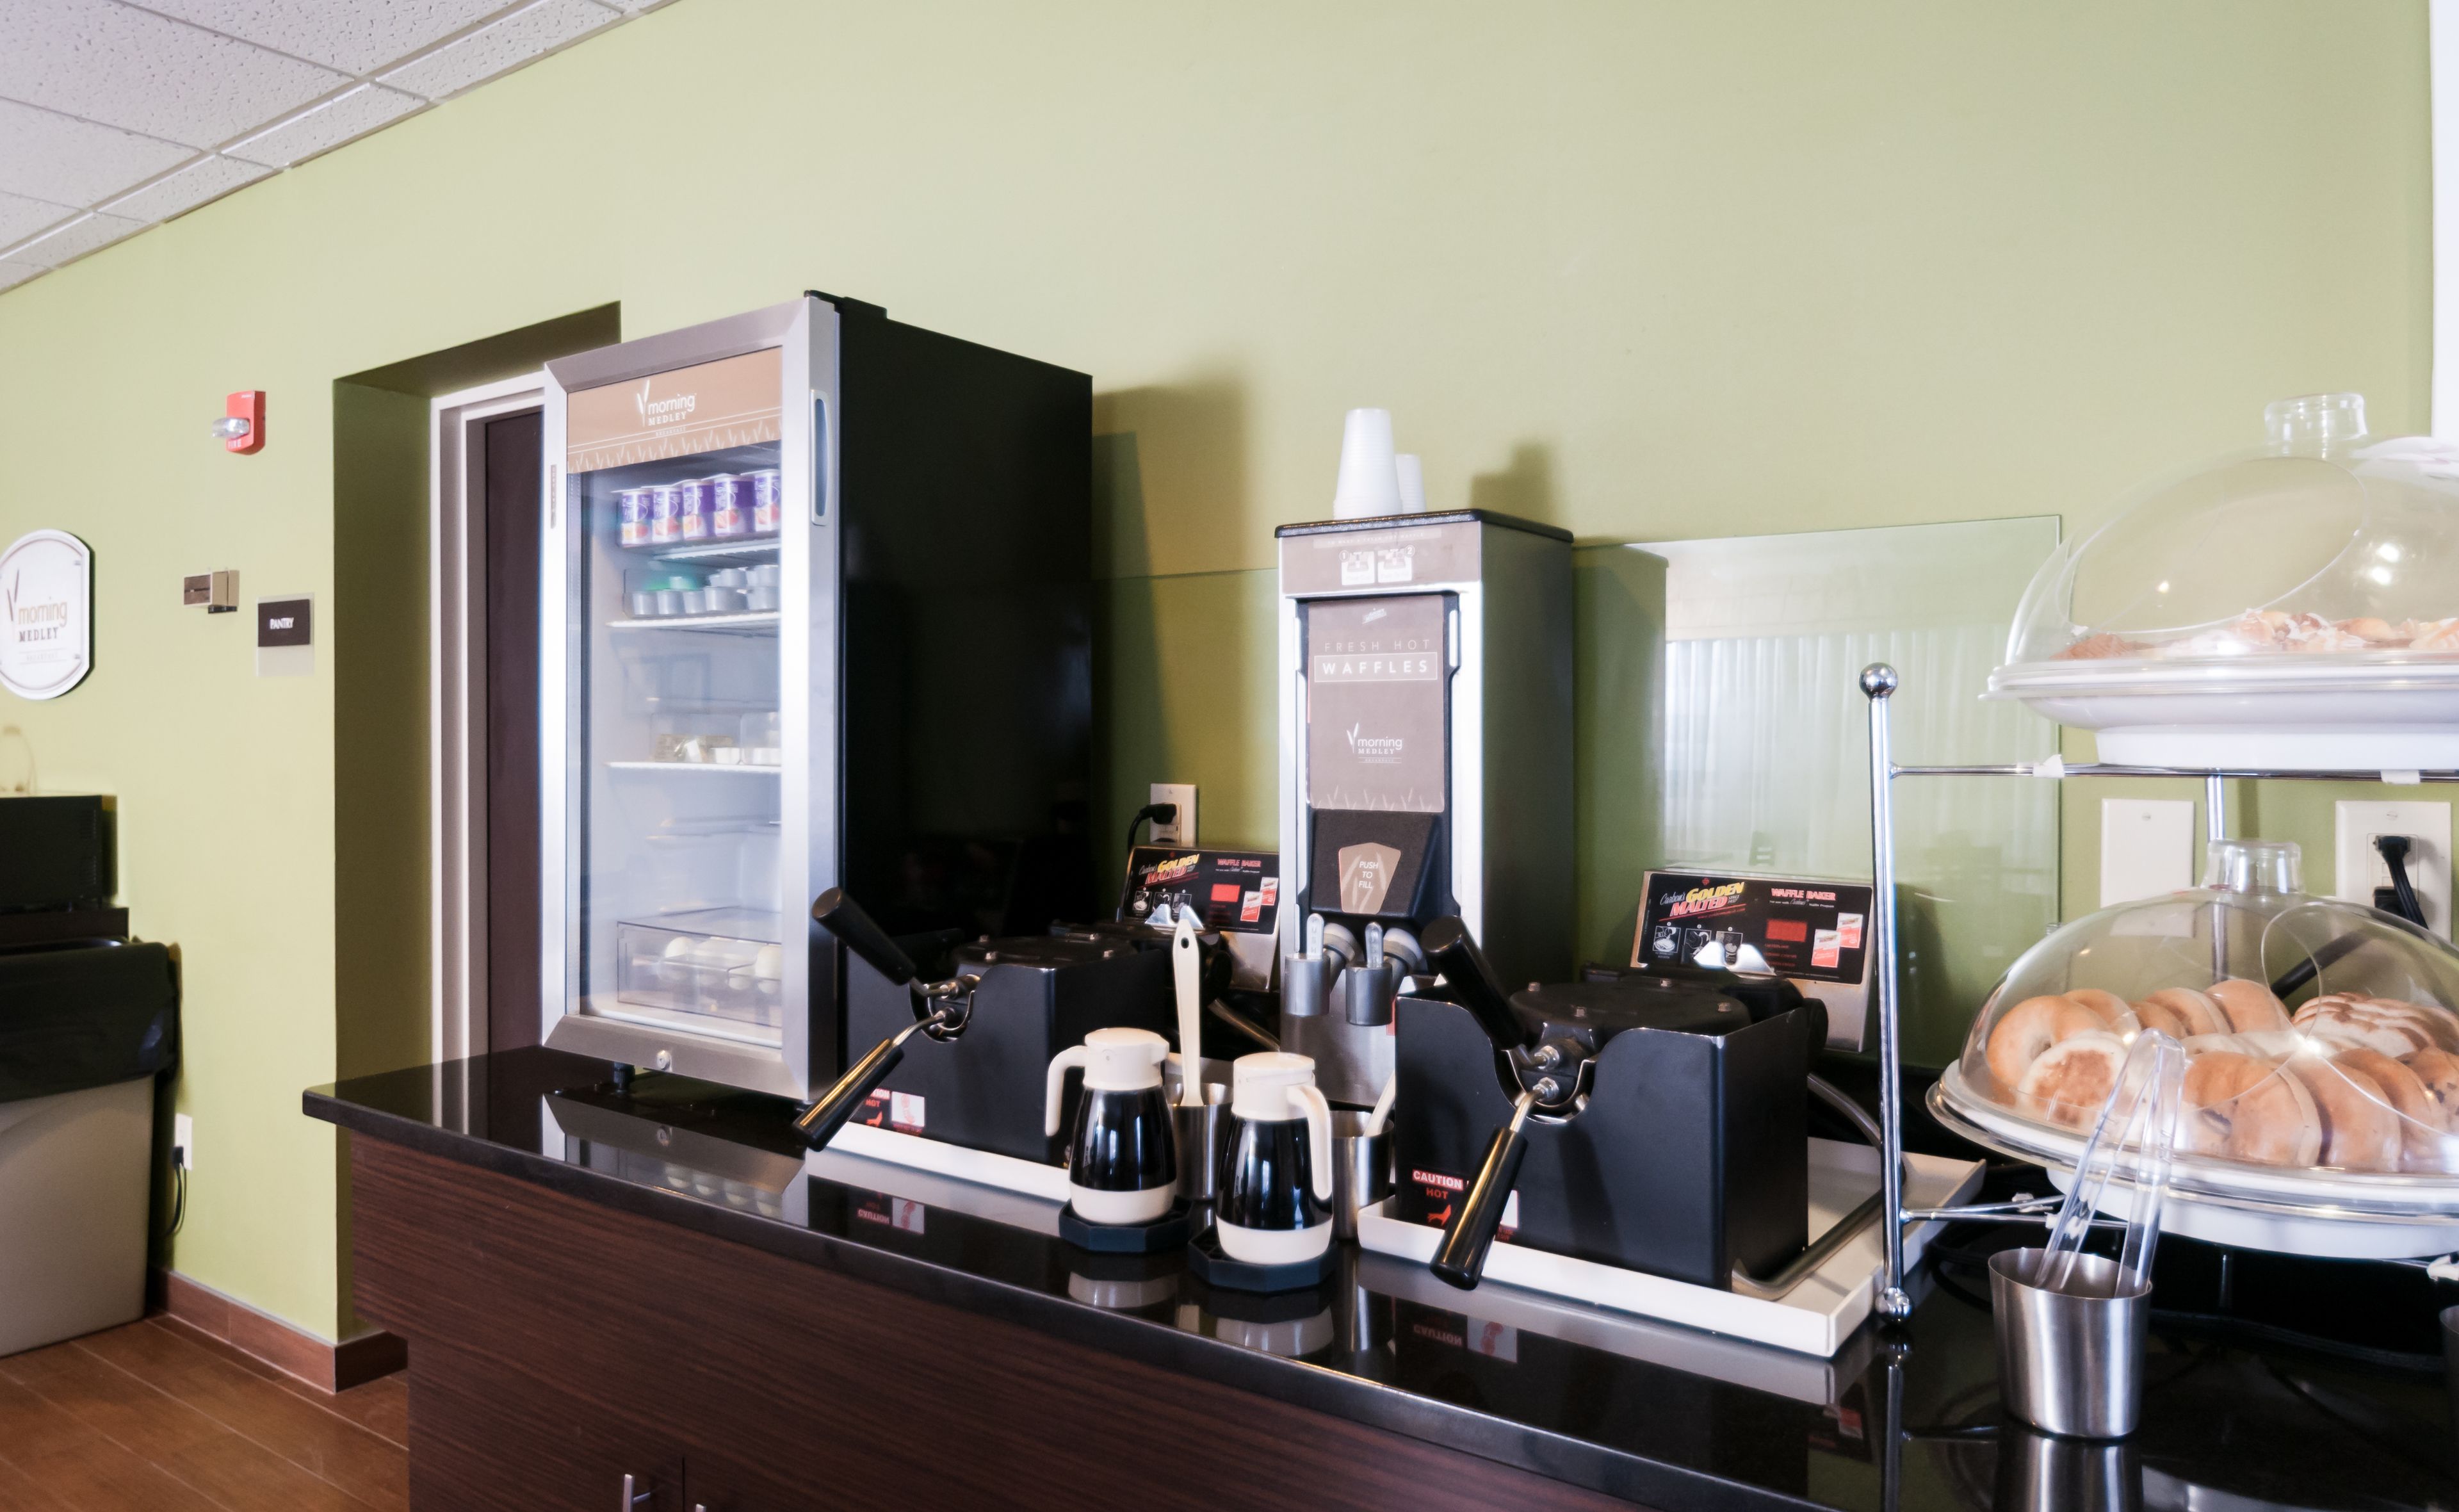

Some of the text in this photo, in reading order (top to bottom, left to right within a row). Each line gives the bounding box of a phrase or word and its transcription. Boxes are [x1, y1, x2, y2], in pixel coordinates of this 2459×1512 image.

[648, 393, 695, 415] morning
[648, 411, 686, 426] MEDLEY
[19, 596, 68, 628] morning
[270, 617, 294, 630] PANTRY
[19, 627, 59, 642] MEDLEY
[1324, 639, 1429, 652] FRESH HOT
[1322, 660, 1427, 674] WAFFLES
[1358, 736, 1402, 751] morning
[1157, 853, 1199, 873] GOLDEN
[1359, 861, 1379, 869] PUSH
[1145, 866, 1187, 884] MALTED
[1358, 881, 1373, 889] FILL
[1685, 881, 1745, 902] GOLDEN
[1771, 888, 1836, 901] WAFFLE BAKER
[1669, 896, 1728, 917] MALTED
[1413, 1170, 1463, 1189] CAUTION
[1426, 1187, 1448, 1199] HOT
